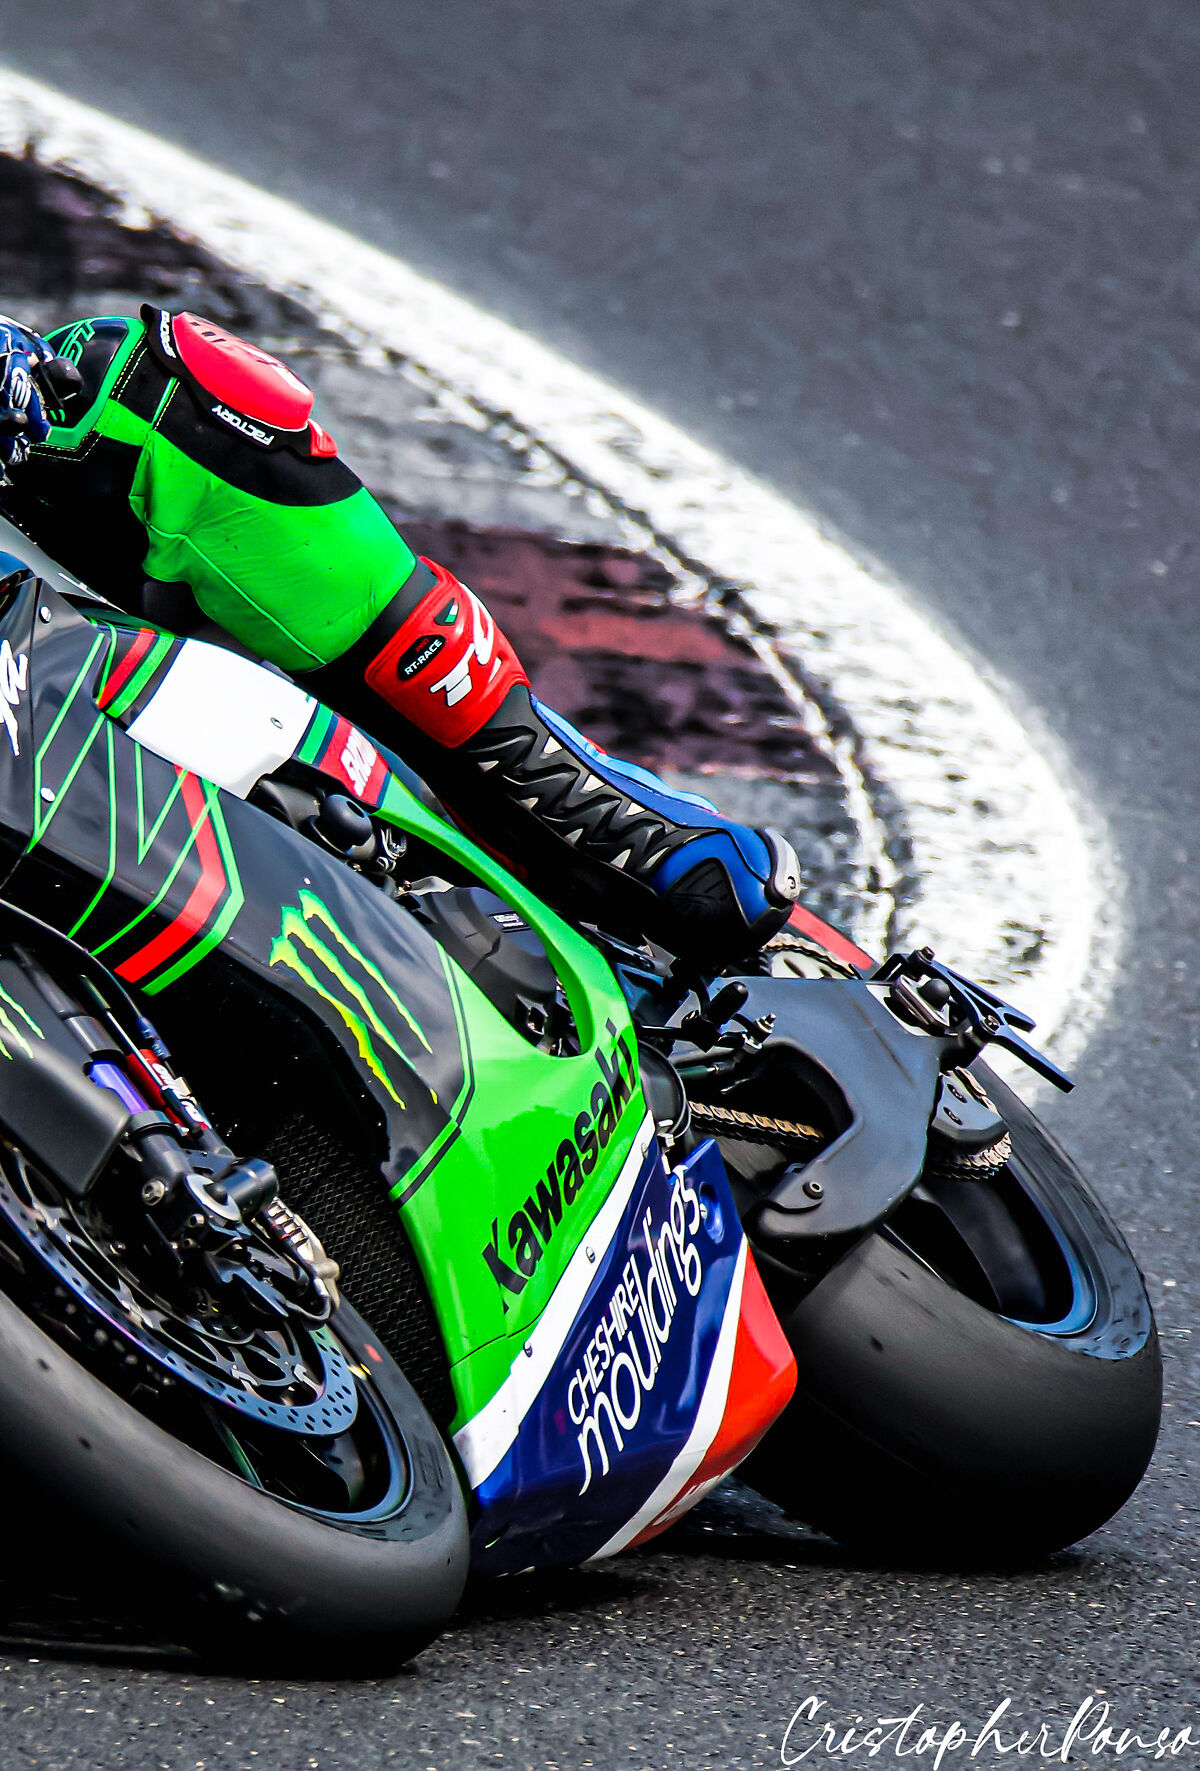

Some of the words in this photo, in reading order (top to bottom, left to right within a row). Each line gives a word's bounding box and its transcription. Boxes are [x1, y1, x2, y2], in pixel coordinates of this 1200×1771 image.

[211, 405, 275, 446] FACTORY
[404, 638, 443, 676] RT-RACE
[482, 1017, 640, 1315] Kawasaki
[568, 1258, 640, 1425] CHESHIRE
[578, 1164, 702, 1497] mouldings
